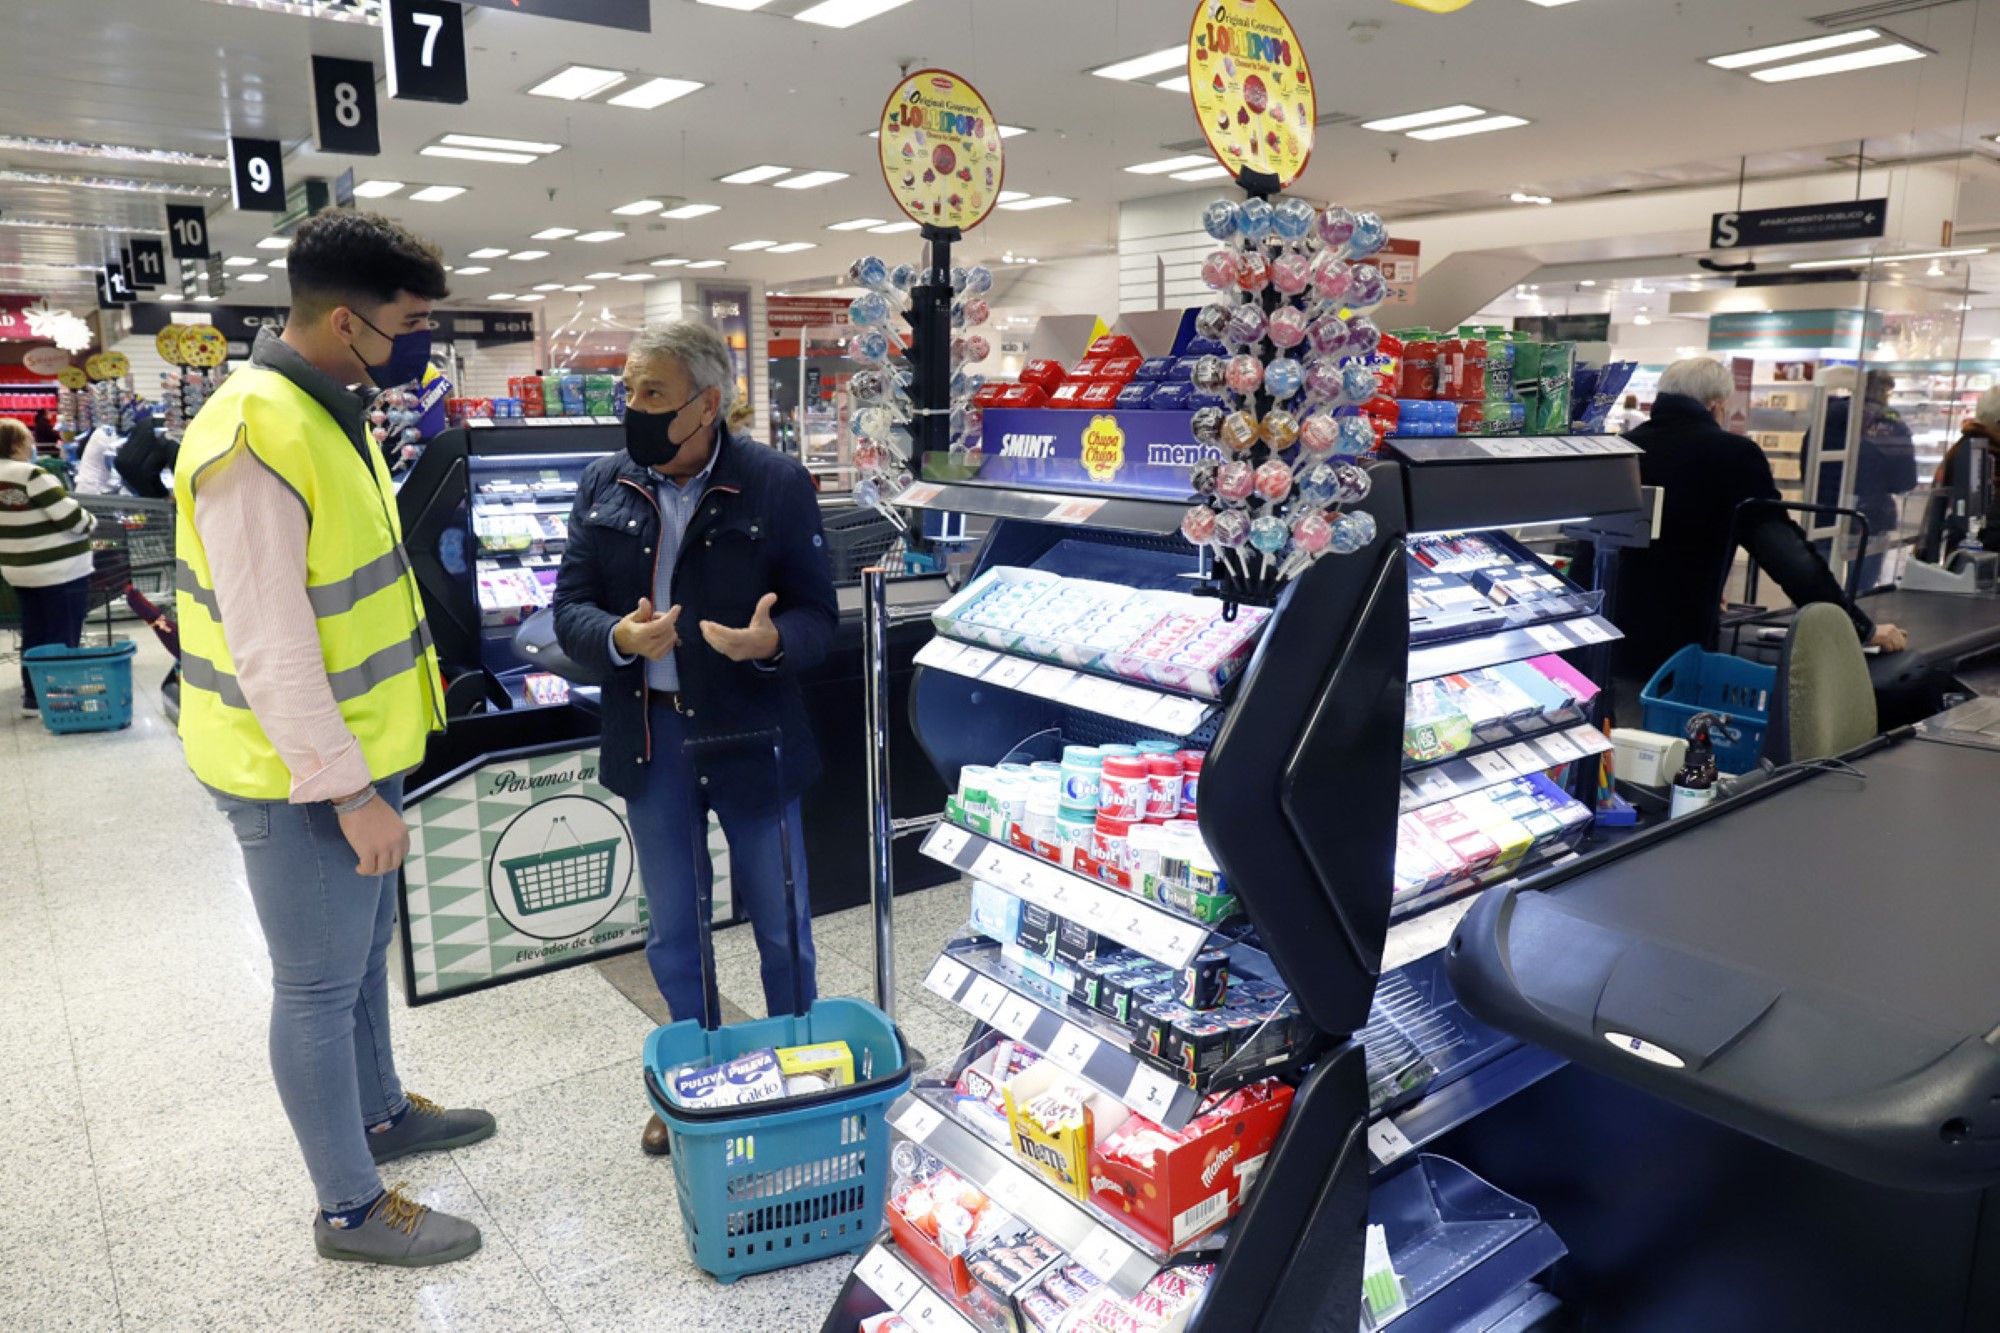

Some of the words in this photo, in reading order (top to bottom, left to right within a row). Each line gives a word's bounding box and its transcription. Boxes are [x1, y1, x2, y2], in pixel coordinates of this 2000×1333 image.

[1215, 5, 1251, 27] Original
[412, 13, 443, 67] 7
[1206, 22, 1292, 67] LOLLIPOPS
[334, 82, 361, 127] 8
[909, 90, 945, 108] Original
[900, 103, 984, 139] LOLLIPOPS
[247, 157, 271, 193] 9
[173, 218, 202, 247] 10
[1715, 213, 1739, 247] S
[138, 250, 160, 275] 11
[1000, 433, 1055, 459] SMINT
[1087, 431, 1119, 448] Chupa
[1085, 447, 1117, 463] Chups
[1148, 443, 1228, 466] mento
[490, 770, 574, 795] Pensamos
[1147, 787, 1177, 804] rbit
[515, 943, 569, 962] Elevador
[572, 937, 587, 948] de
[589, 929, 624, 943] cestas
[727, 1055, 772, 1078] PULEVA
[680, 1072, 722, 1091] PULEVA
[736, 1082, 779, 1105] Calcio
